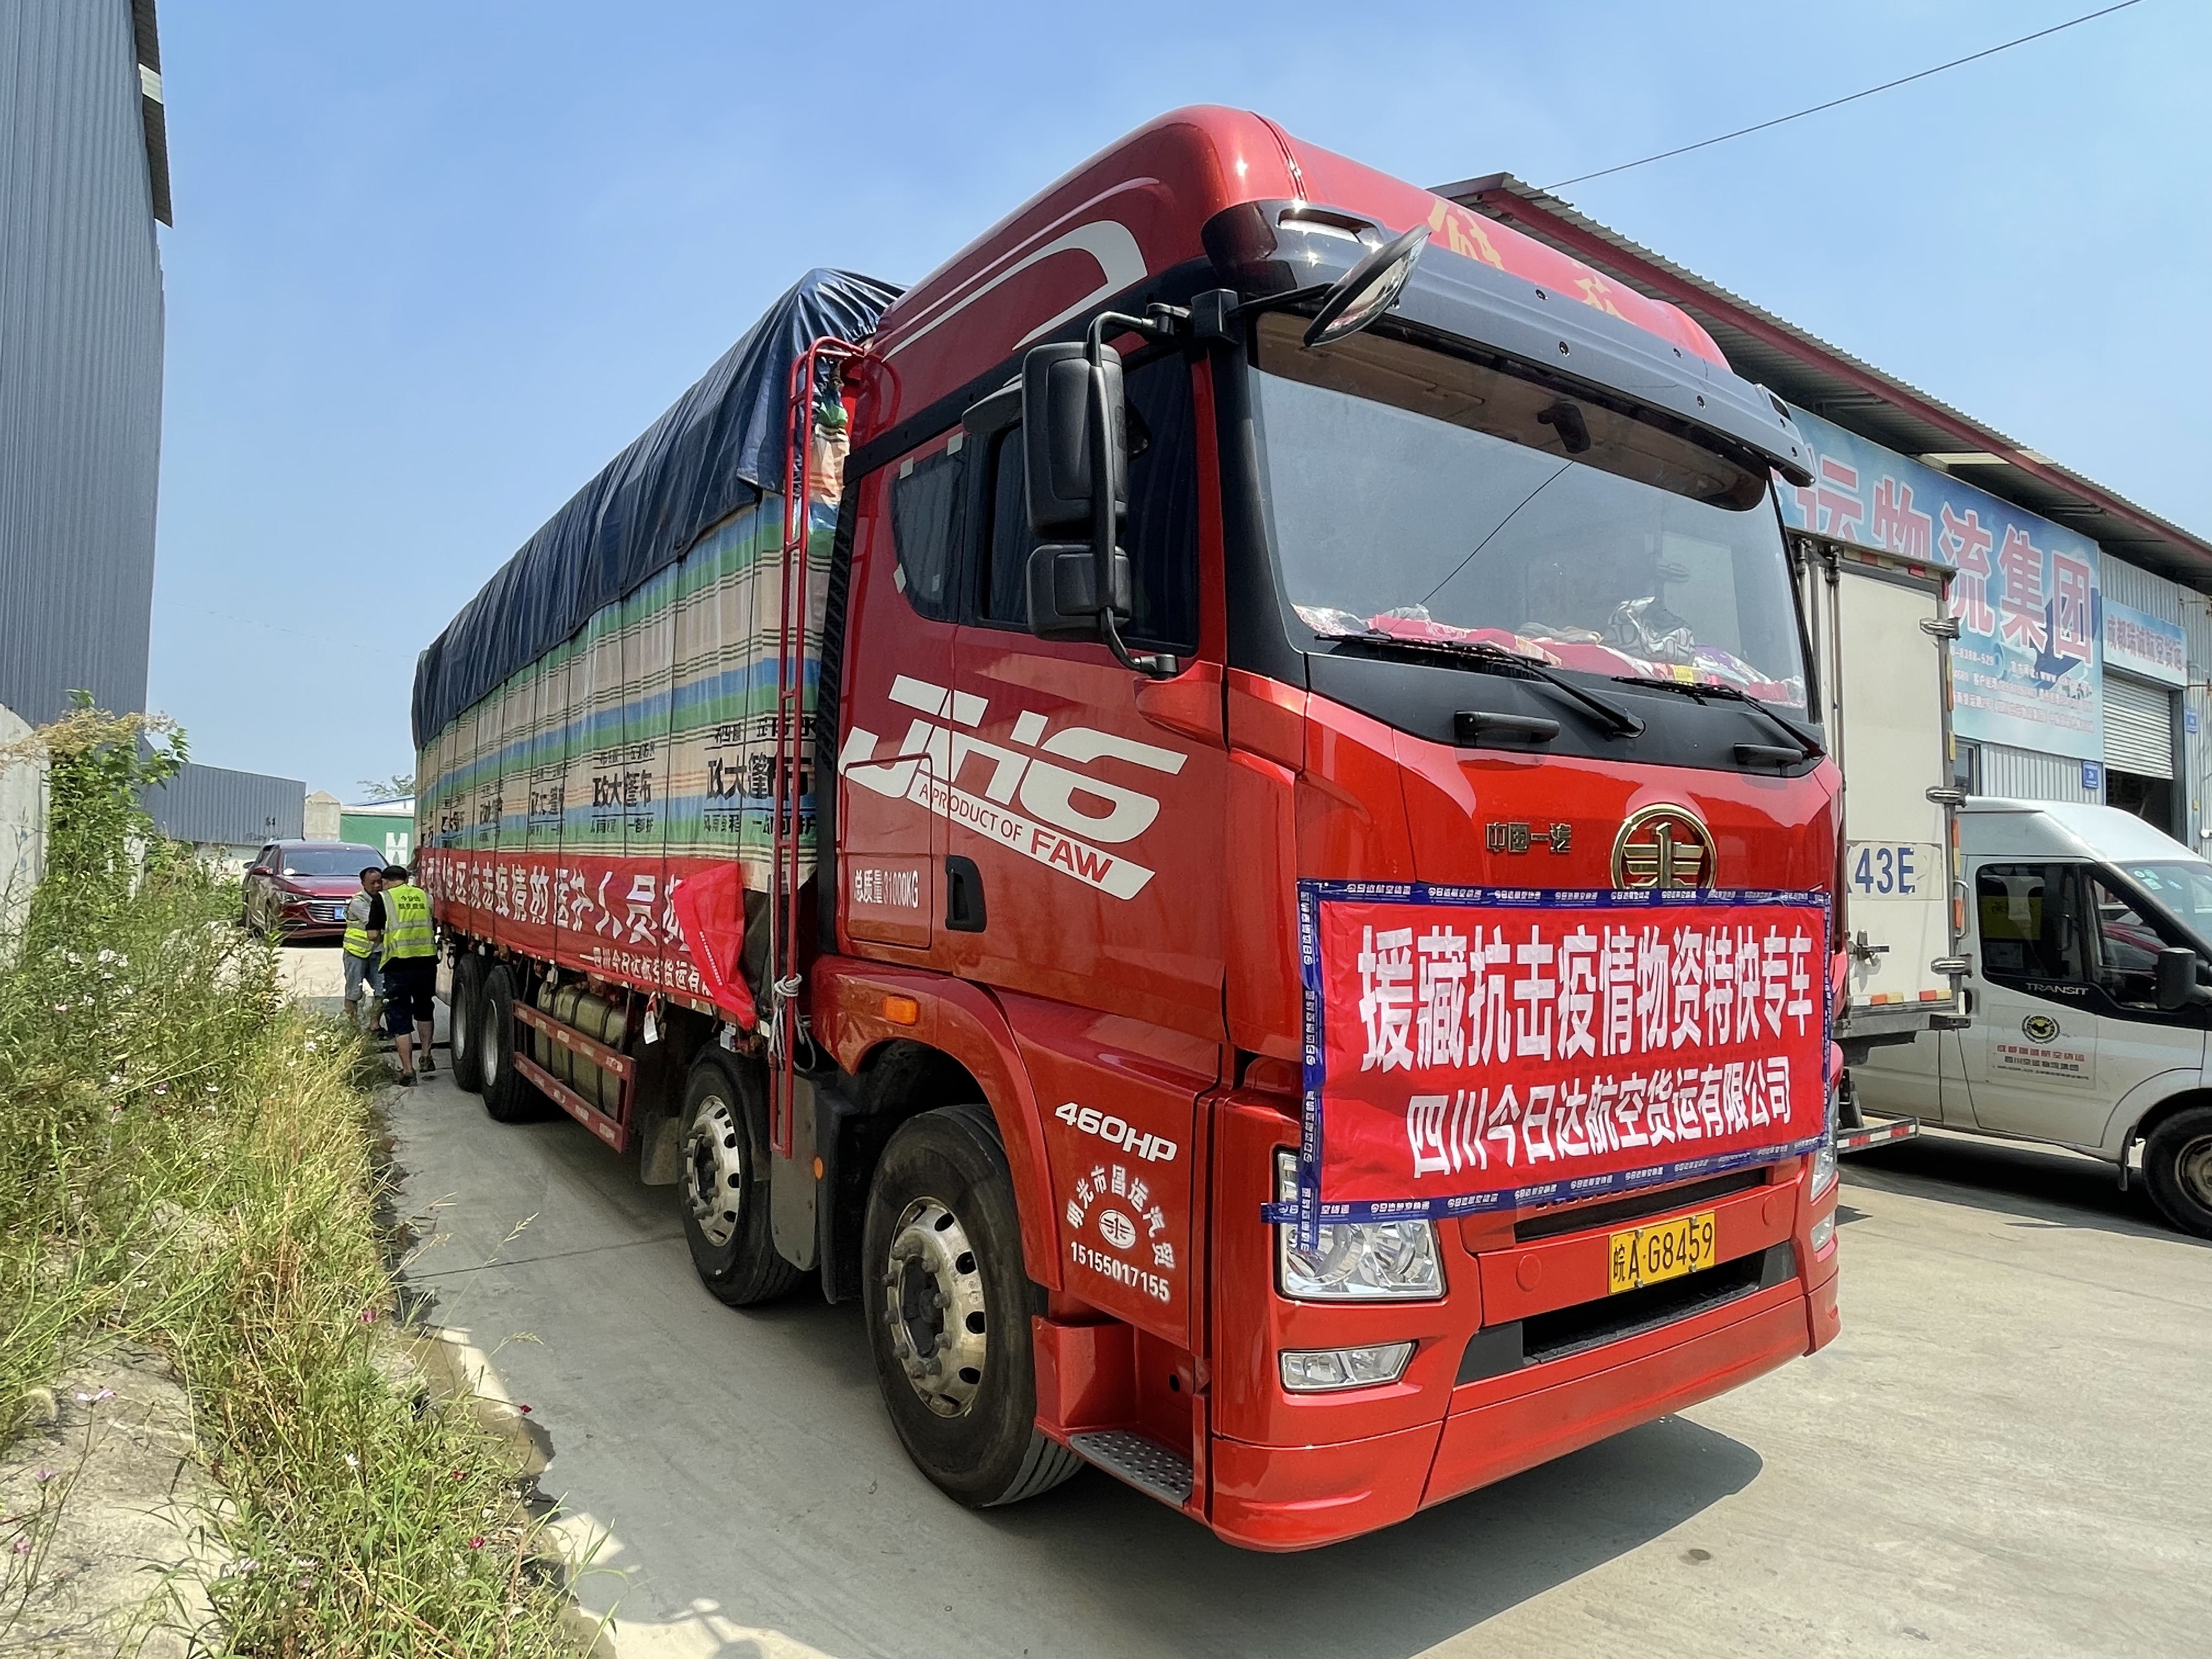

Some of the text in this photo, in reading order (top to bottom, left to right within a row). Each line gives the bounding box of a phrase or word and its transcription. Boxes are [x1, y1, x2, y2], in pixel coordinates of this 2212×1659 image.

[1770, 443, 2093, 667] 运物流集团
[919, 783, 1113, 883] A PRODUCT OF FAW
[1847, 845, 1916, 894] 43E
[1357, 924, 1813, 1073] 援藏抗击疫情物资特快专车
[2025, 982, 2089, 995] TRANSIT
[1055, 1102, 1178, 1162] 460HP
[1407, 1056, 1791, 1179] 四川今日达航空货运有限公司
[1071, 1241, 1171, 1305] 15155017155
